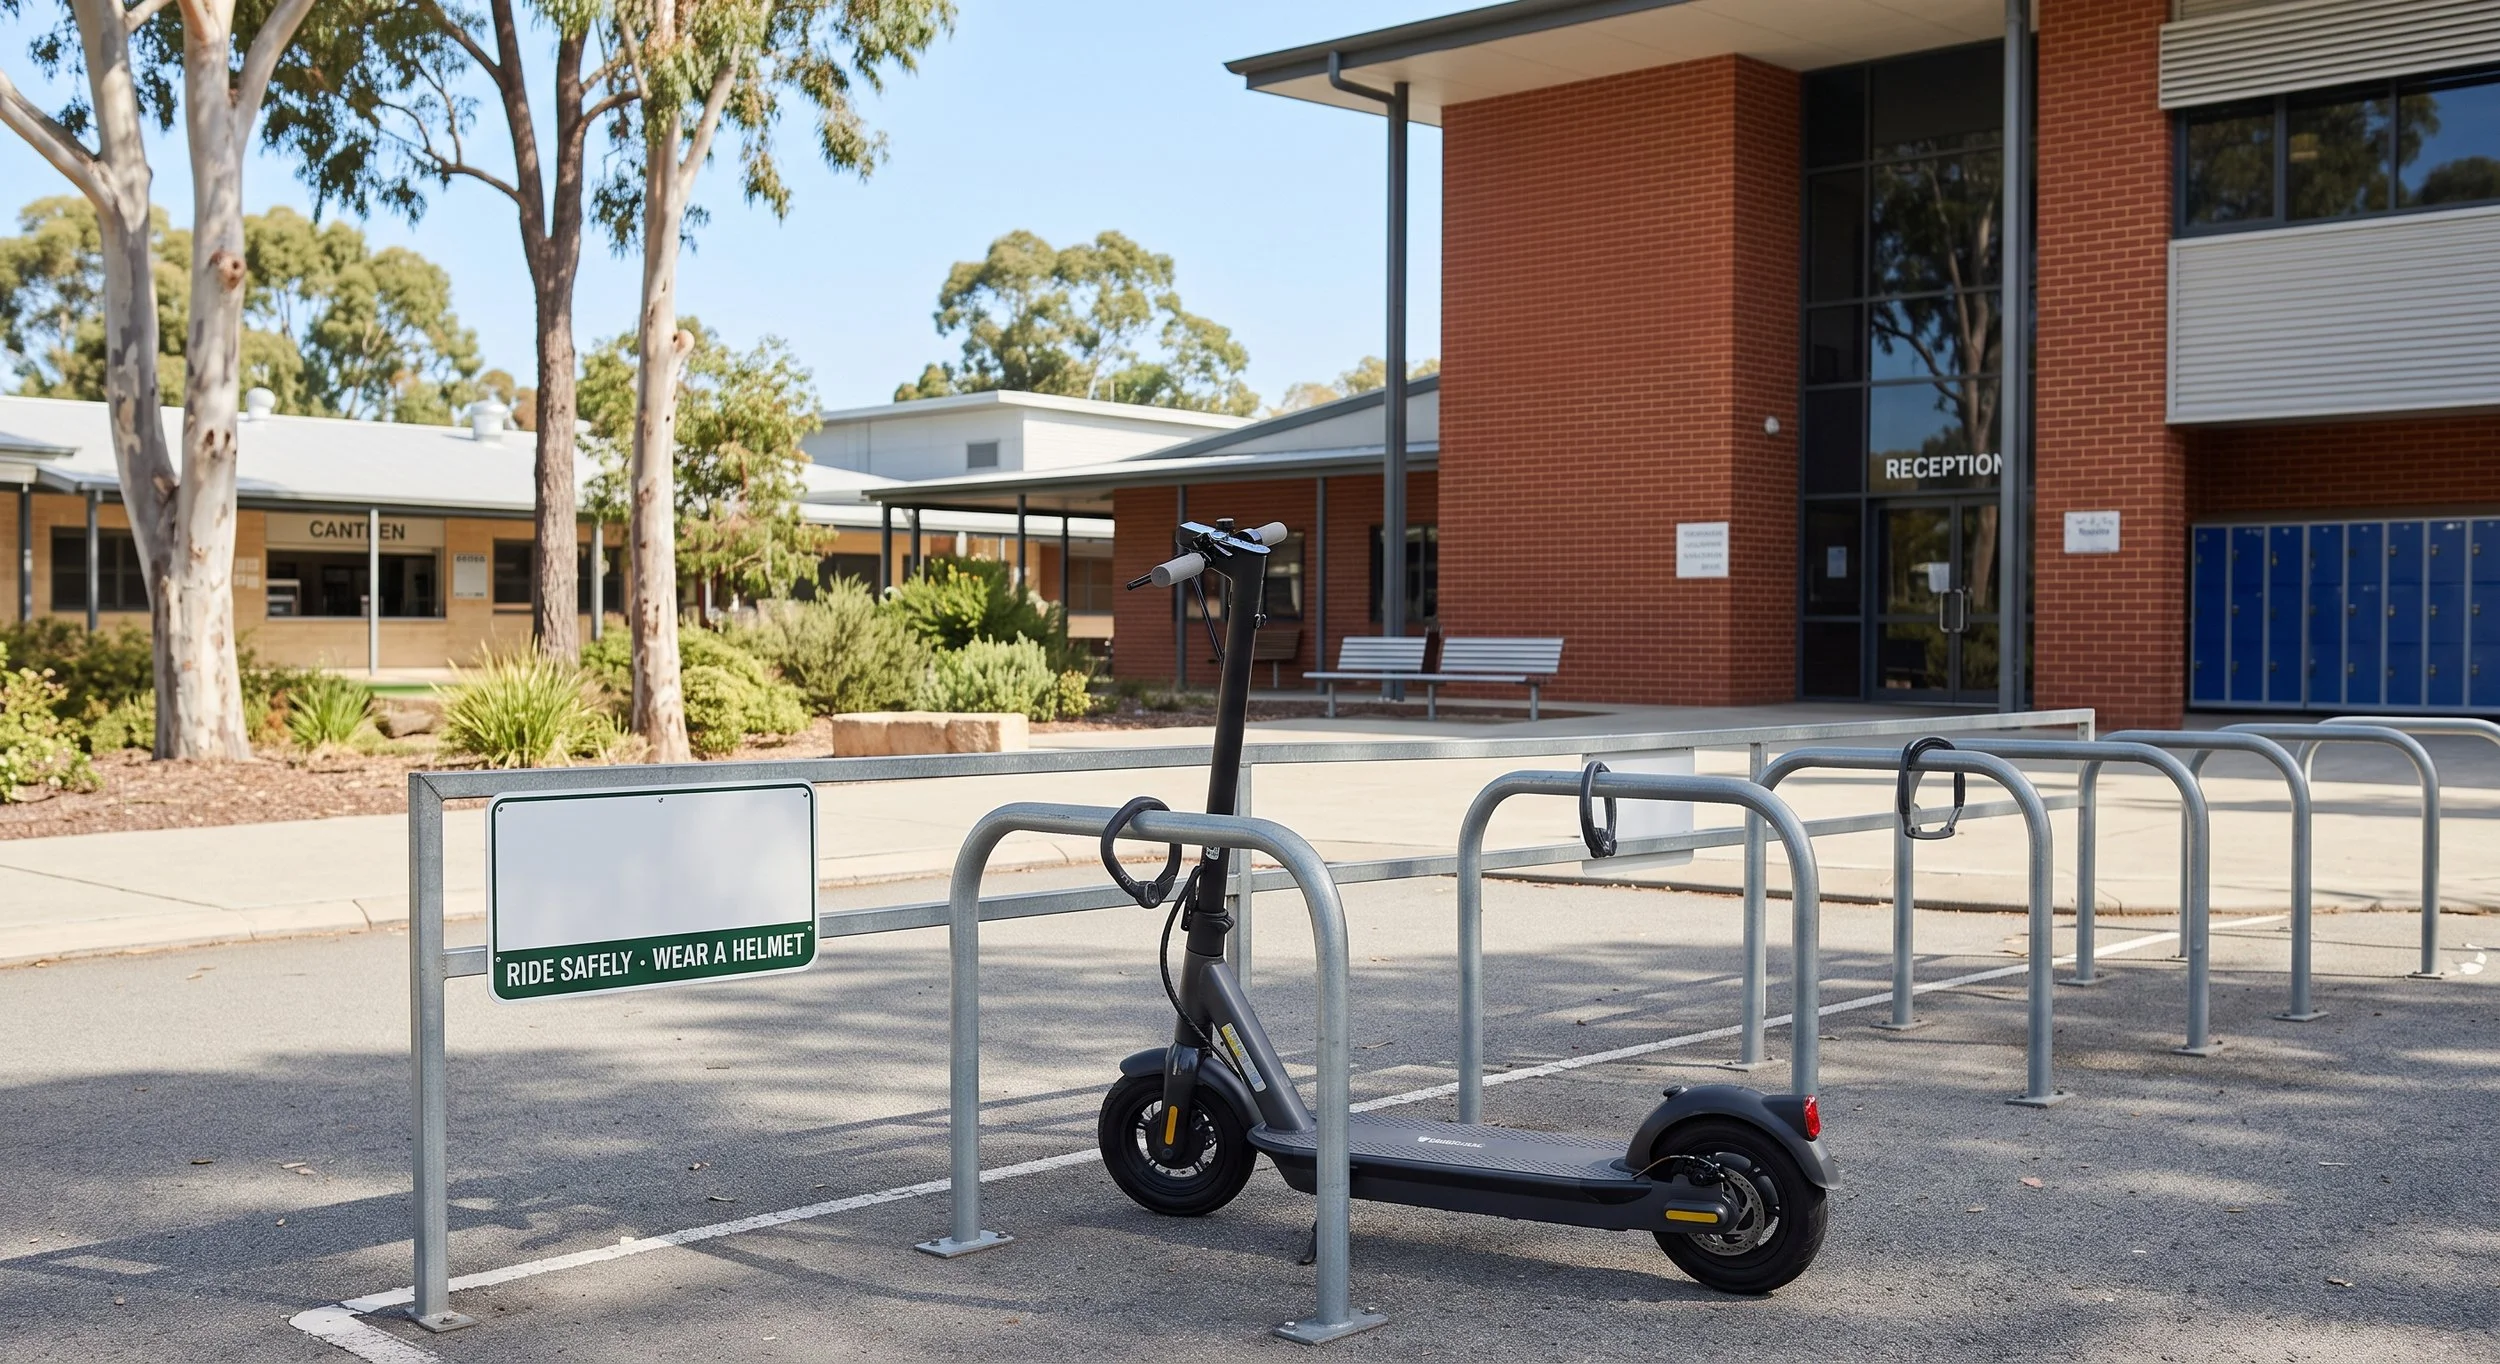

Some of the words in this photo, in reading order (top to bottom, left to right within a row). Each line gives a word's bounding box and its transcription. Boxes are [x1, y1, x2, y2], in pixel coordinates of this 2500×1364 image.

[506, 959, 555, 987] RIDE
[560, 951, 633, 981] SAFELY
[652, 943, 709, 970] WEAR
[713, 941, 728, 964] A
[732, 933, 805, 961] HELMET
